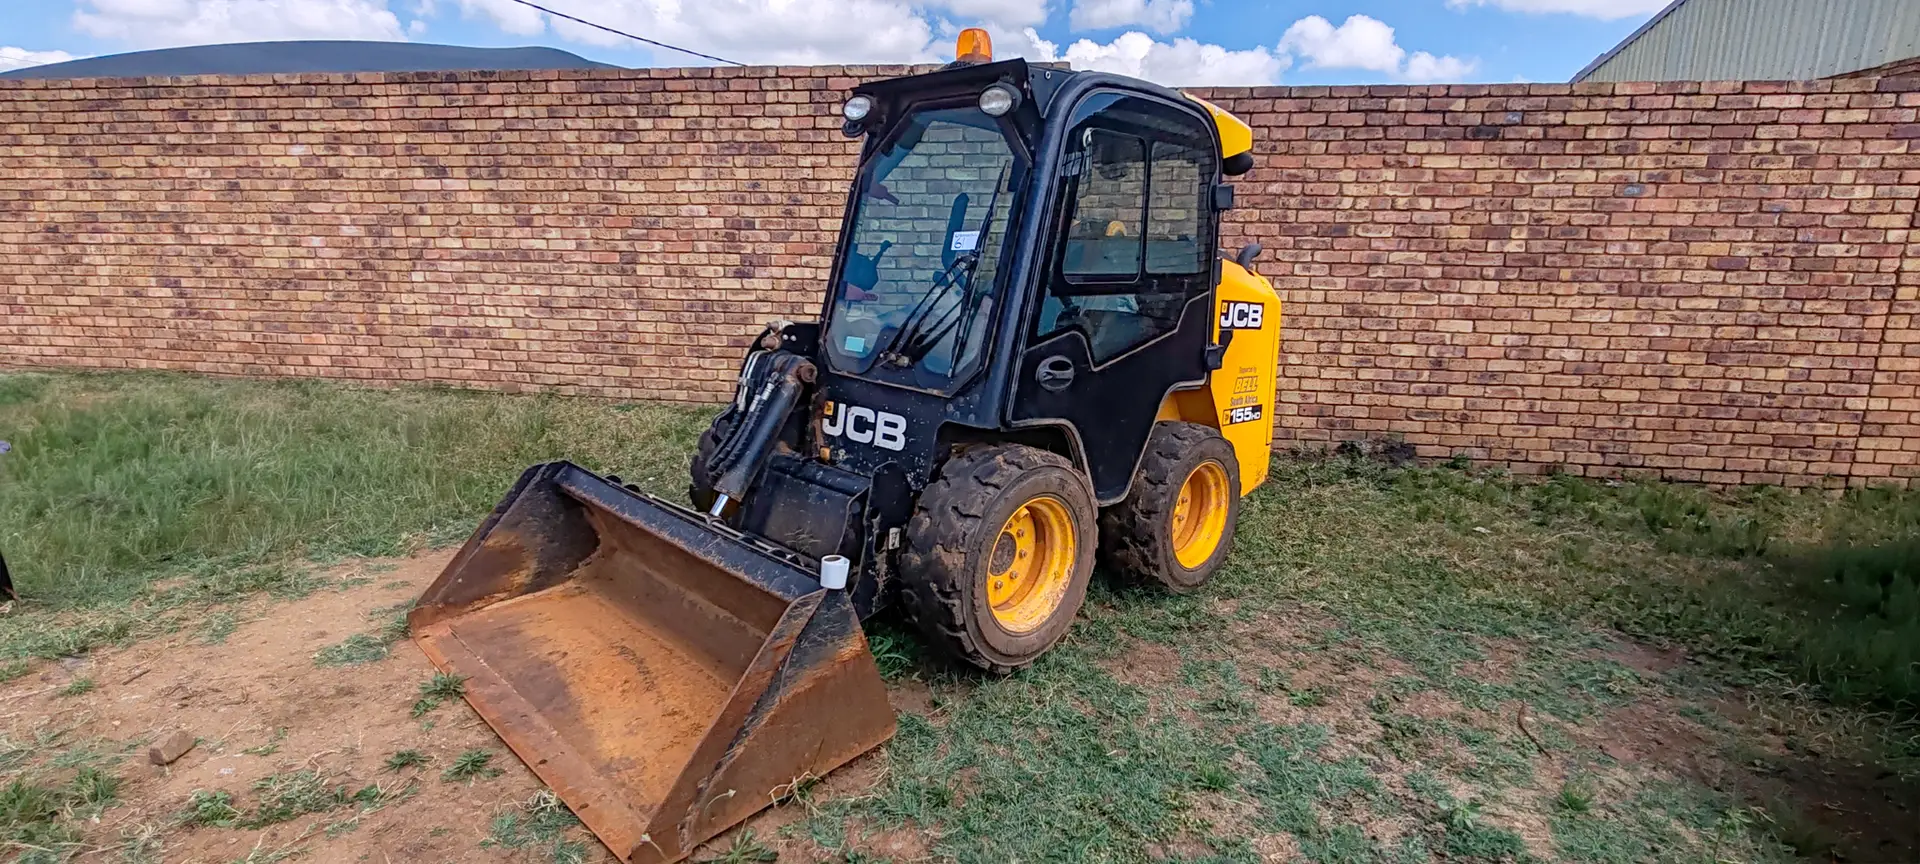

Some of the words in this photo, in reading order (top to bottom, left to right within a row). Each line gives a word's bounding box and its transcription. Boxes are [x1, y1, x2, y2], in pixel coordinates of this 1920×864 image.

[1221, 303, 1262, 327] JCB
[1233, 375, 1259, 394] BELL
[822, 403, 907, 451] JCB
